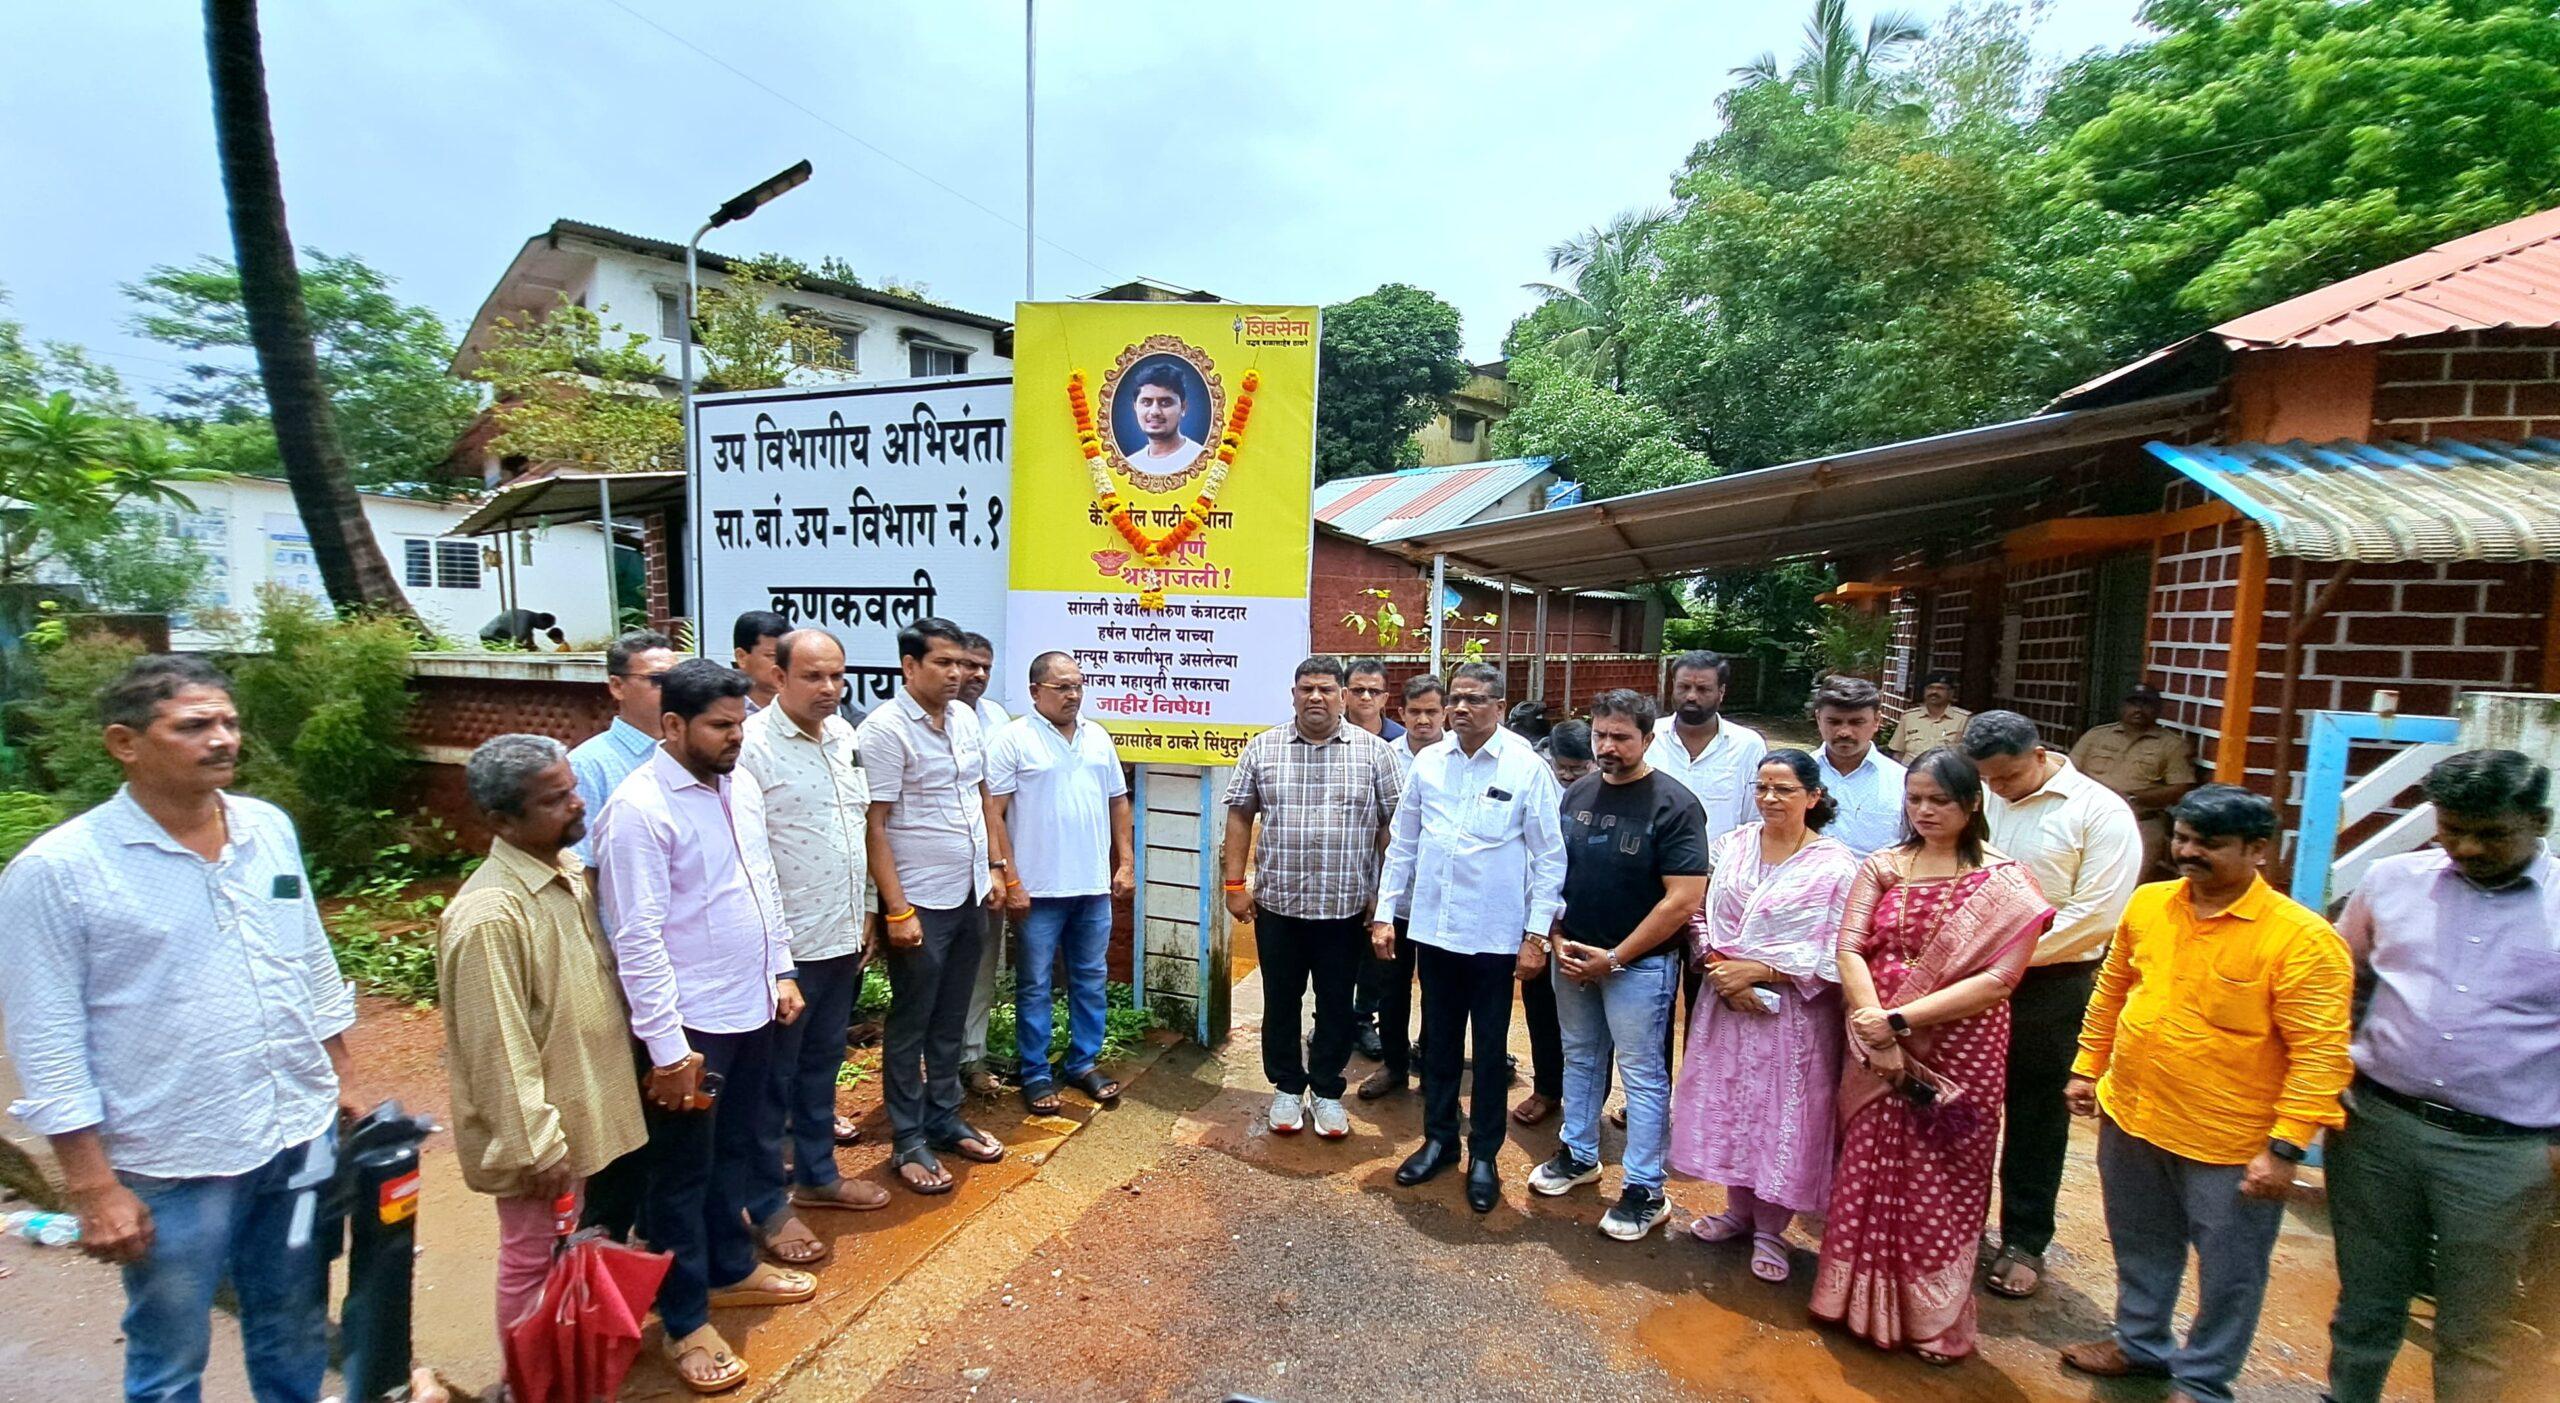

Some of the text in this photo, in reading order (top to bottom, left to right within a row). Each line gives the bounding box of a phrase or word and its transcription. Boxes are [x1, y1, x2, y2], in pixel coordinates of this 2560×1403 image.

[1245, 316, 1310, 337] शिवसेना
[711, 402, 1006, 473] उप विभागीय अभियंता
[767, 568, 937, 628] कणकवली
[1067, 597, 1247, 621] सांगली येथील तरुण कंत्राटदार
[1098, 621, 1214, 643] हर्षल पाटील याच्या
[1073, 648, 1238, 672] मृत्यूस कारणीभूत असलेल्या
[1081, 672, 1230, 695] भाजप महायुती सरकारचा
[1096, 693, 1211, 716] जाहीर निषेध!
[1166, 730, 1199, 750] ठाकरे
